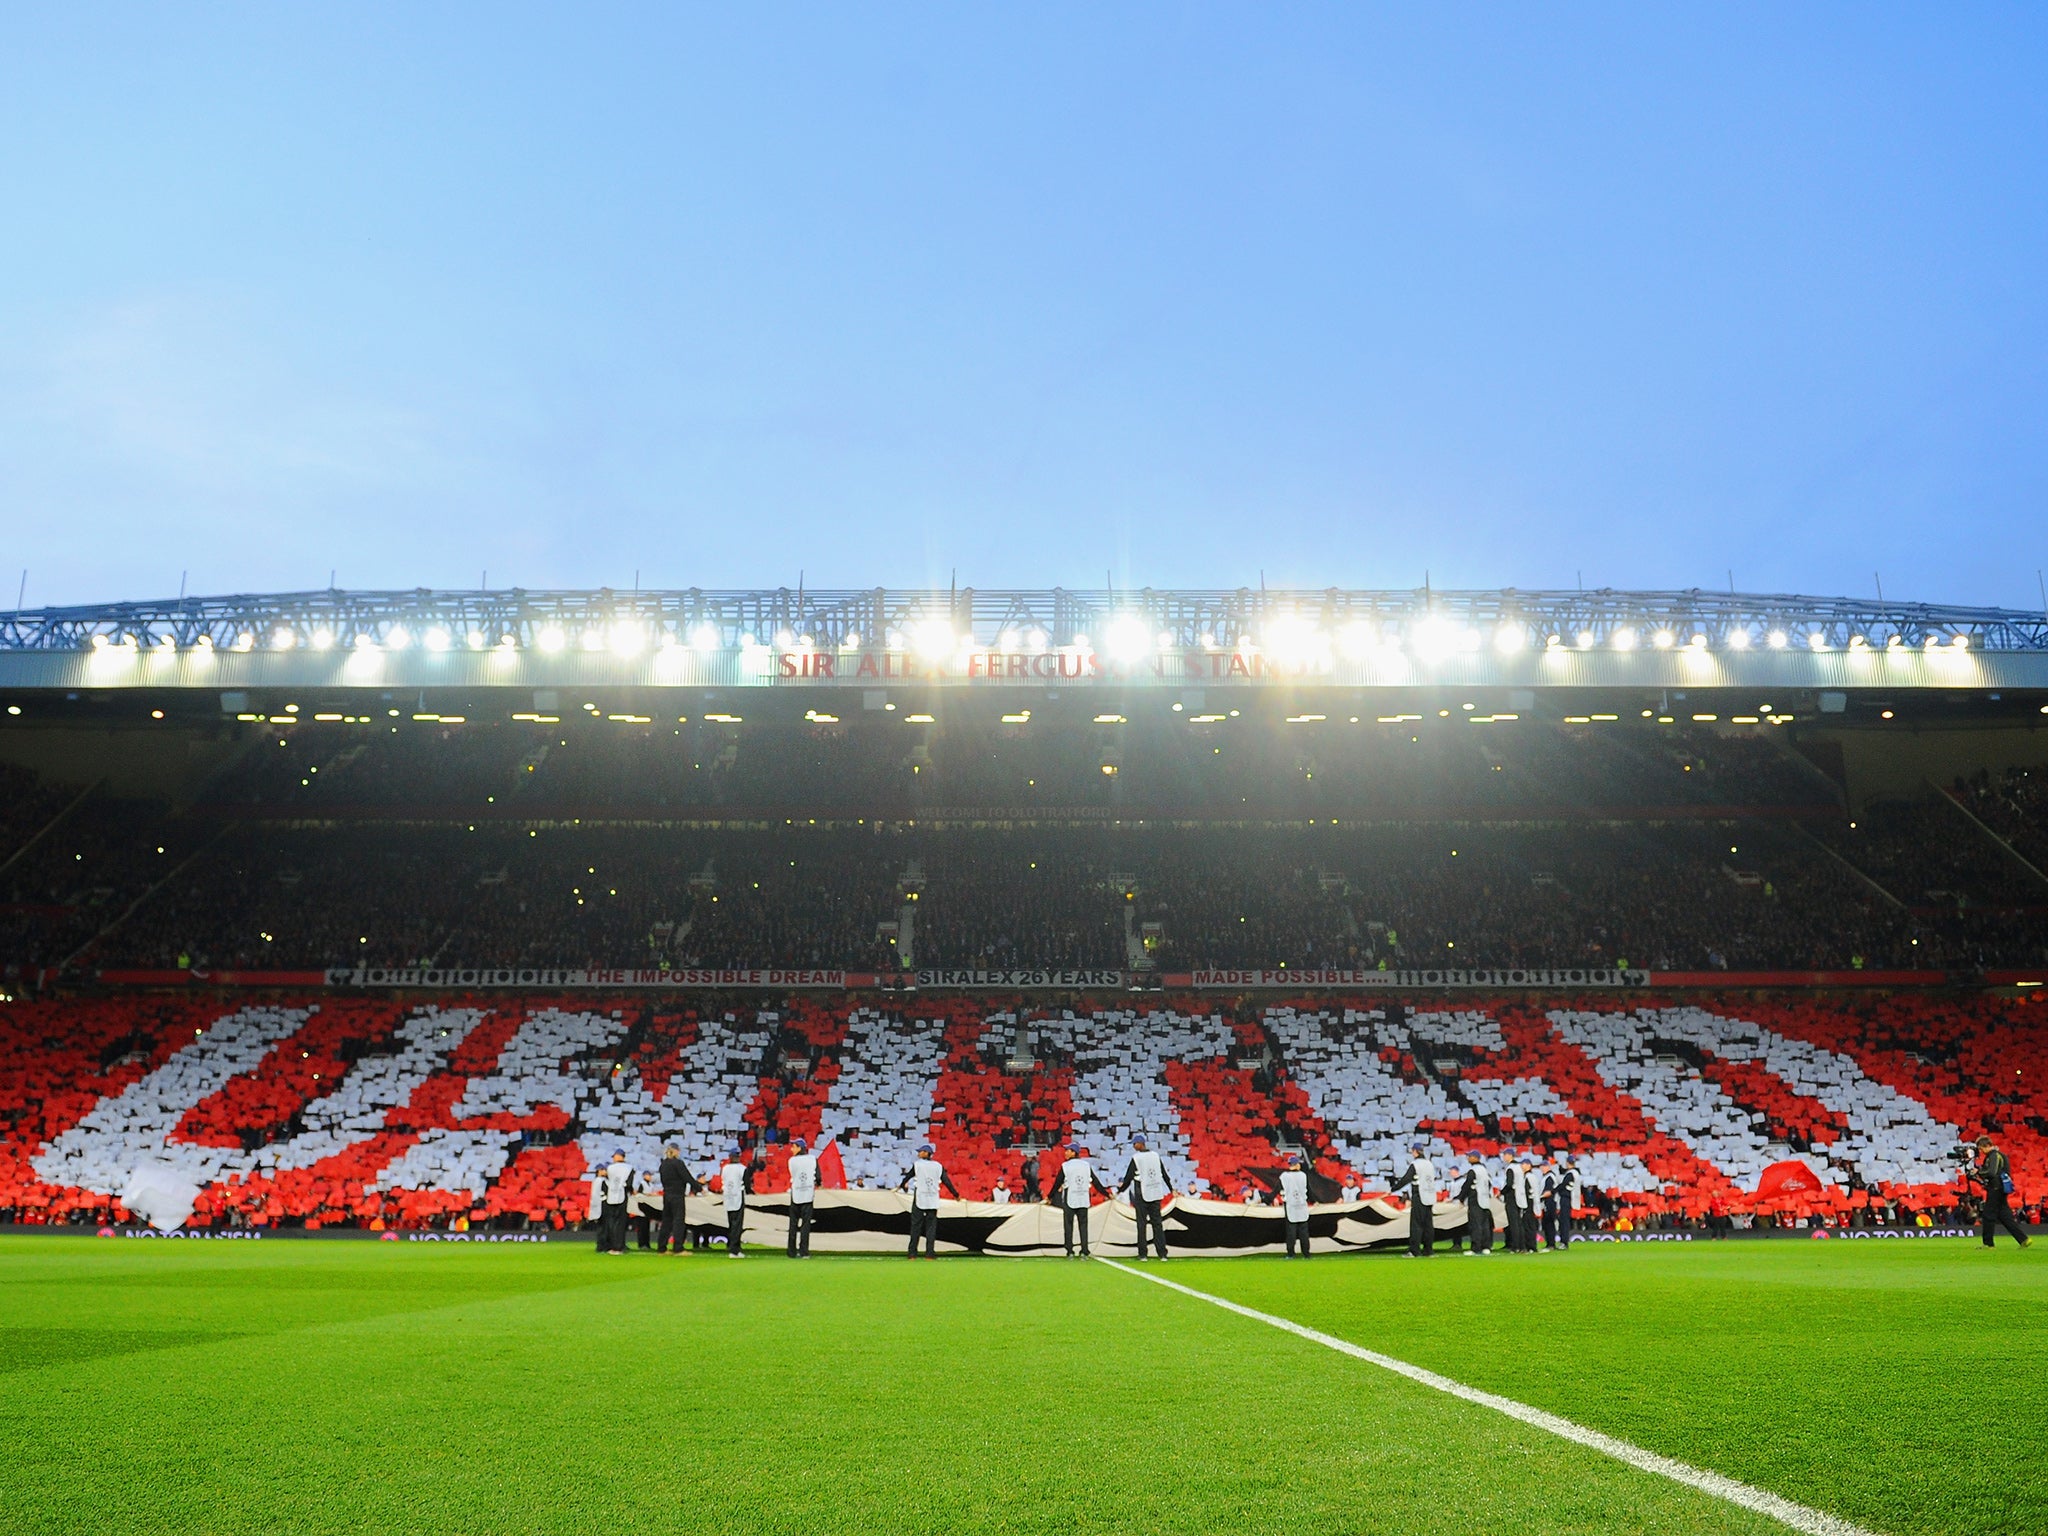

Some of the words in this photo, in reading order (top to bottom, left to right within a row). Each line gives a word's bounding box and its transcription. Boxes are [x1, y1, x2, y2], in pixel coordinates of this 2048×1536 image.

[778, 653, 834, 679] SIR
[1008, 806, 1037, 818] OLD
[1041, 806, 1111, 818] TRAFFORD
[584, 970, 625, 984] THE
[633, 970, 761, 985] IMPOSSIBLE
[771, 970, 842, 985] DREAM
[1195, 971, 1254, 985] MADE
